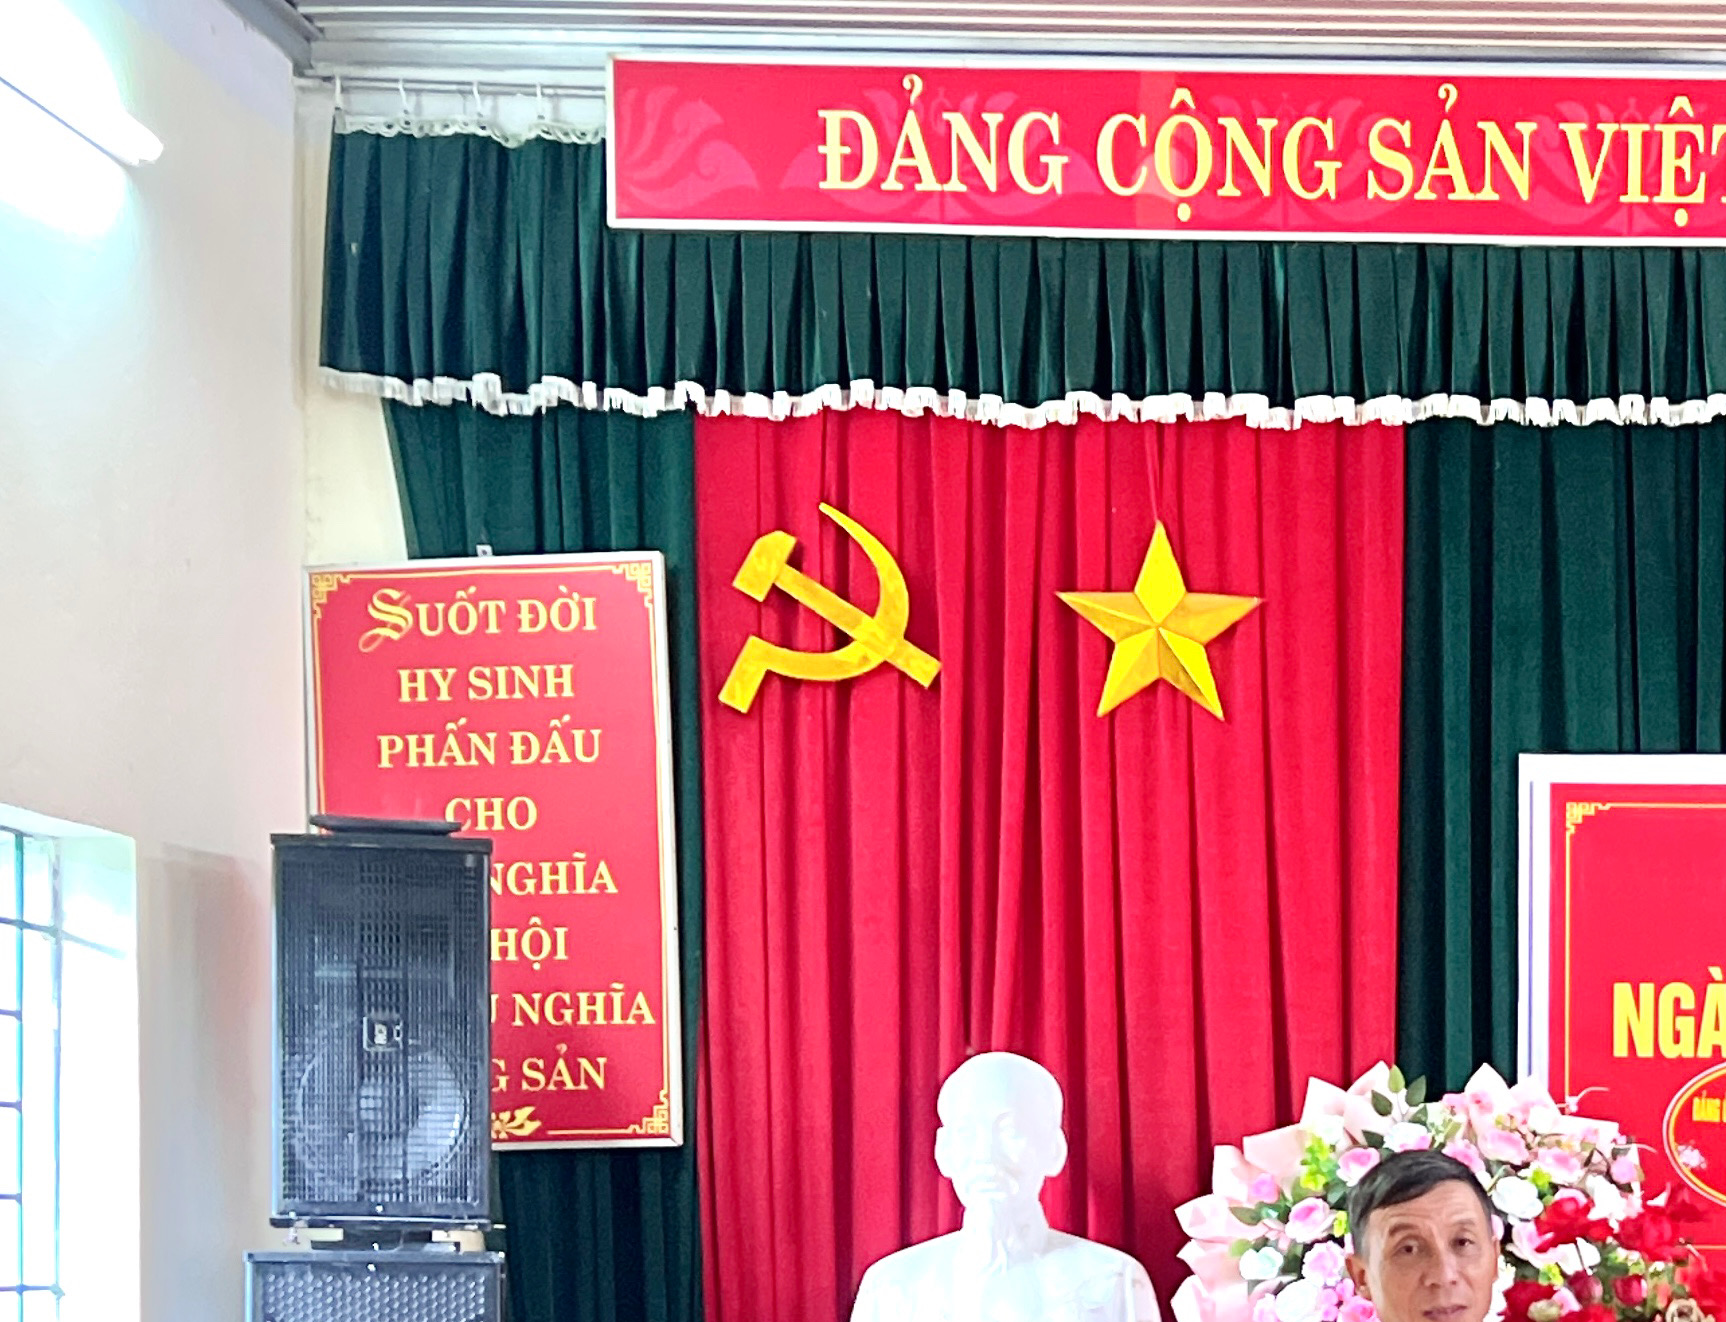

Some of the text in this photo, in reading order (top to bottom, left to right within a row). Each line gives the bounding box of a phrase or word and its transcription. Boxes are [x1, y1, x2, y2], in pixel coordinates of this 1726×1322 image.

[818, 75, 1068, 194] ĐẢNG
[1097, 88, 1342, 221] CỘNG
[1367, 83, 1536, 200] SẢN
[360, 585, 596, 651] SUỐT ĐỜI
[399, 664, 574, 702] HY SINH
[378, 714, 601, 767] PHẤN ĐẤU
[446, 797, 537, 830] CHO
[490, 917, 569, 970] HỘI
[512, 983, 655, 1025] NGHĨA
[522, 1044, 606, 1090] SẢN
